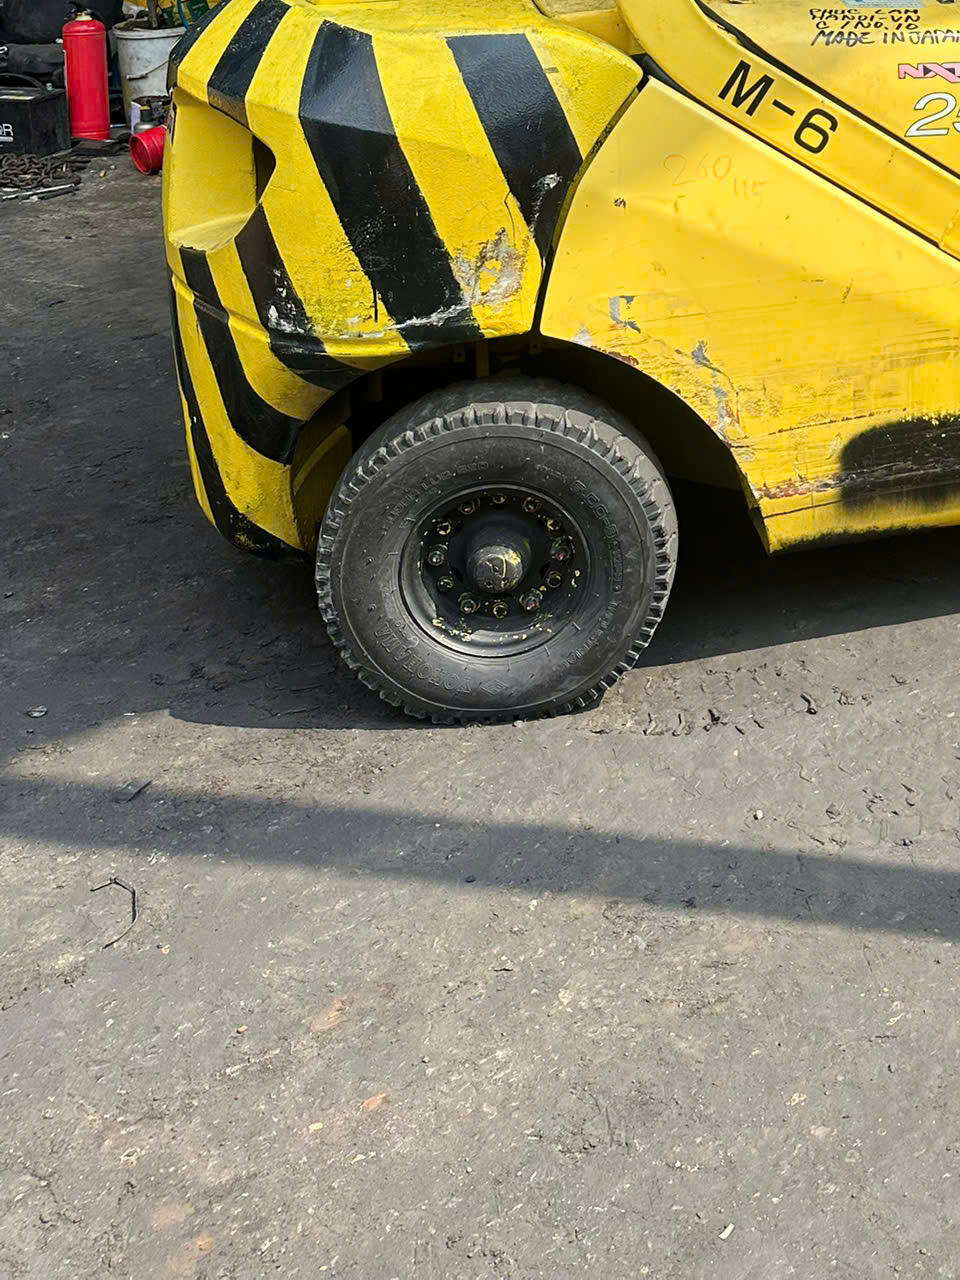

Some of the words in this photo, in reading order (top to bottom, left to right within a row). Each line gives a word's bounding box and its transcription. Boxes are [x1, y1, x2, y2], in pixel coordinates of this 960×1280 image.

[810, 29, 876, 48] MADE
[718, 59, 839, 154] M-6
[374, 621, 472, 694] YOKOHAMA
